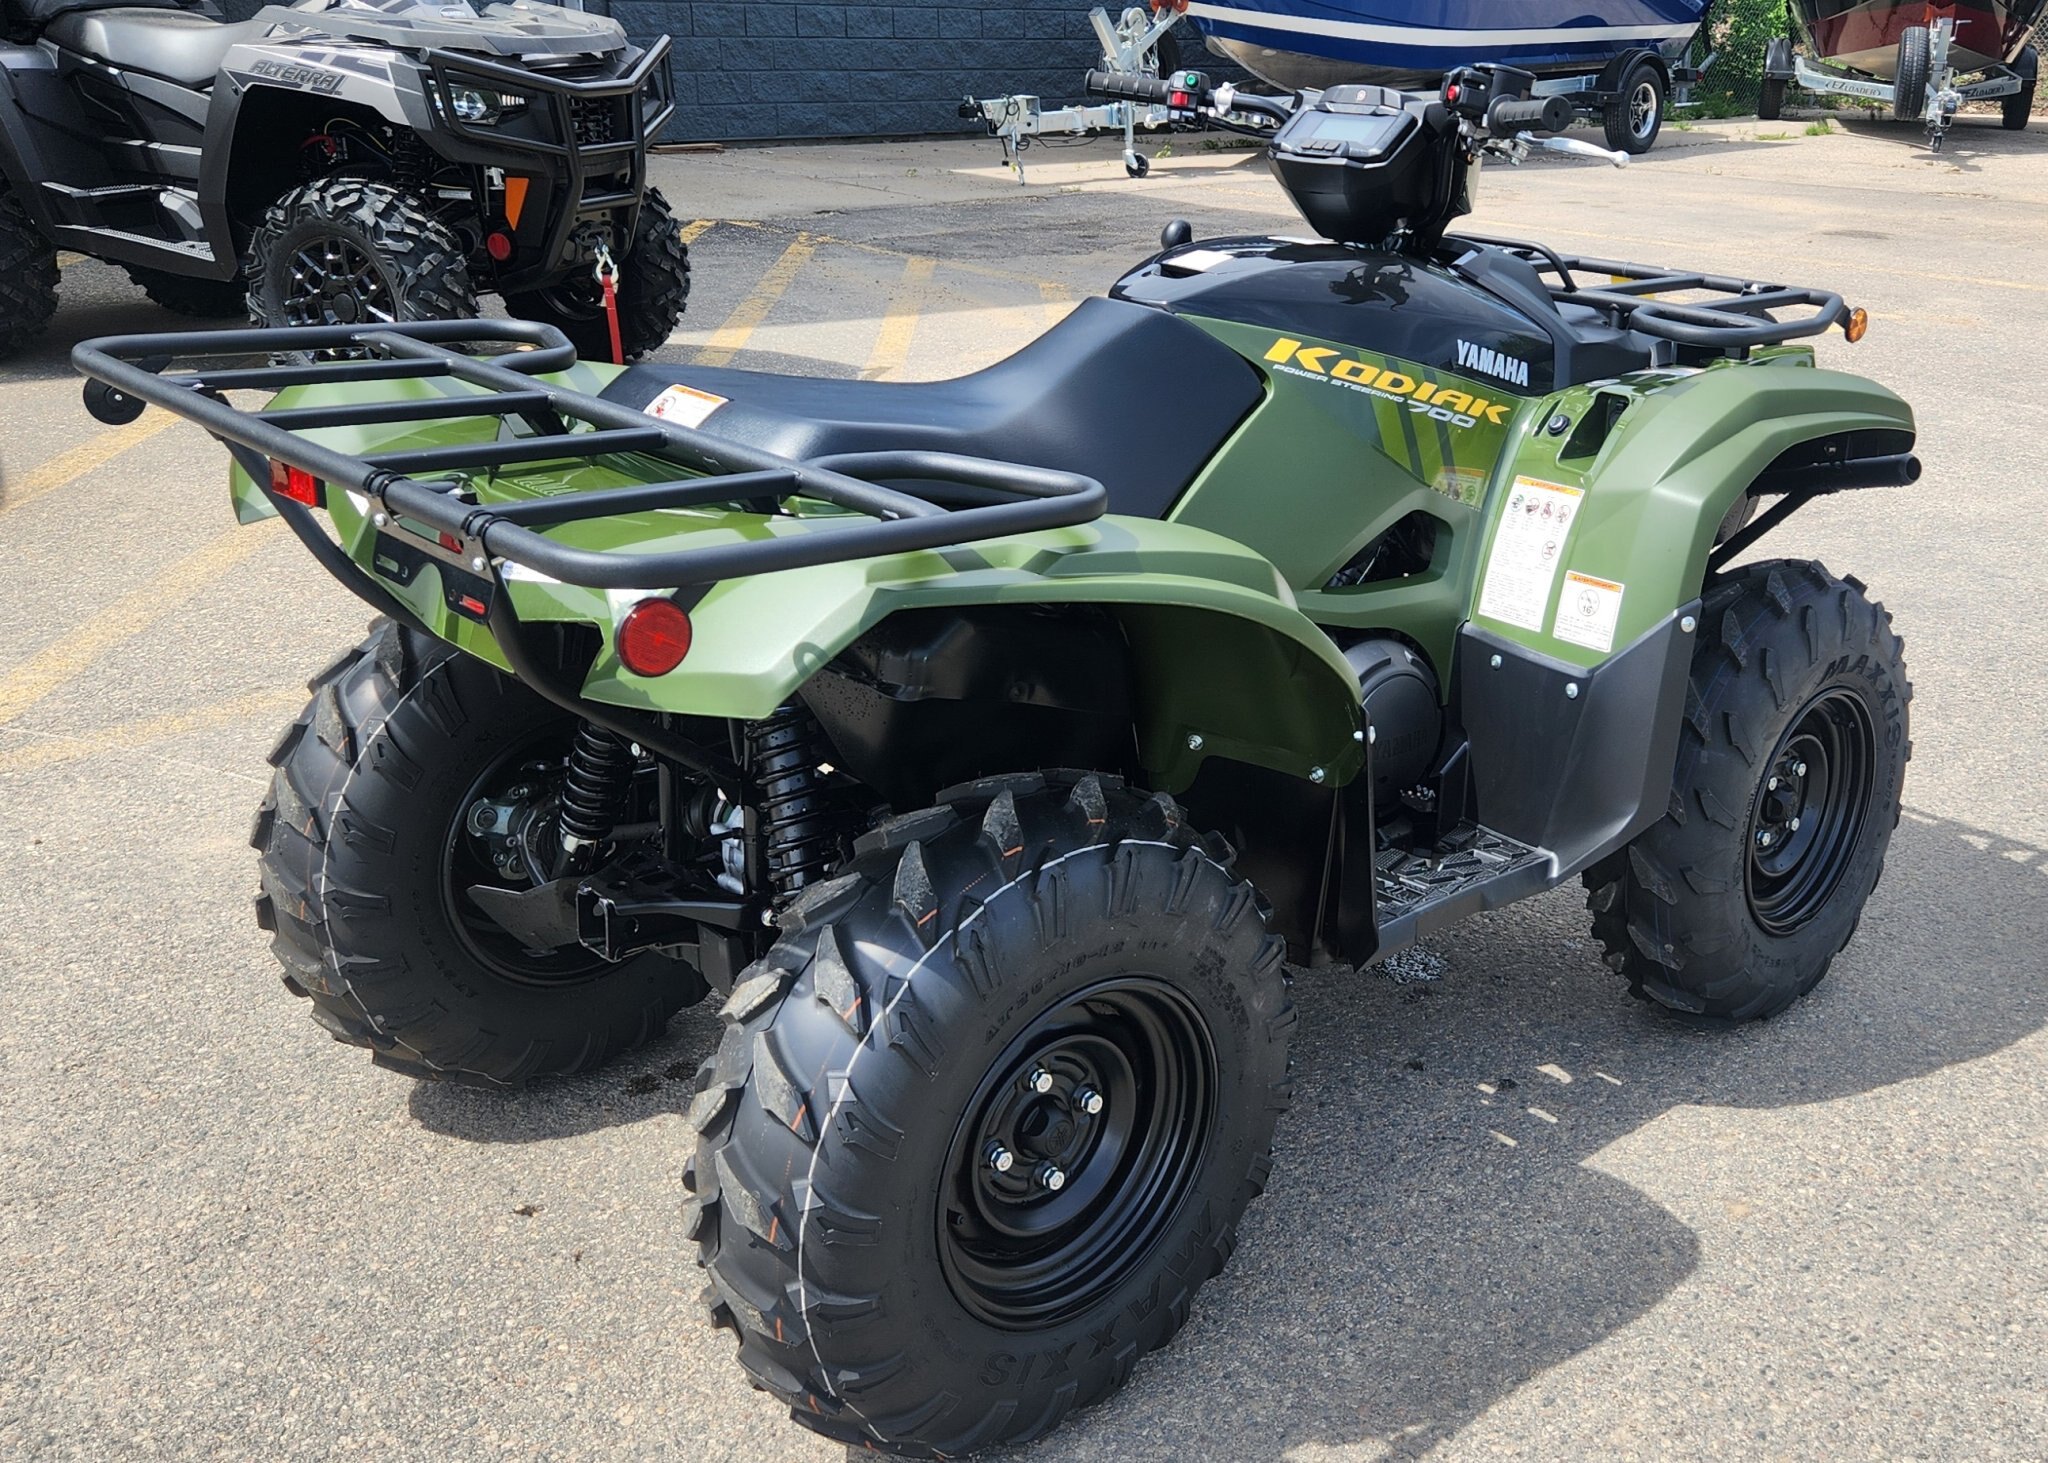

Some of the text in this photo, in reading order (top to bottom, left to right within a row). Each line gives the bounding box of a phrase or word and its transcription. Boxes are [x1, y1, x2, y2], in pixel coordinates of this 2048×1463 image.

[248, 60, 336, 89] ALTERRA
[1263, 337, 1511, 425] KODIAK
[1272, 363, 1477, 429] POWER STEERING 700
[1457, 338, 1529, 387] YAMAHA
[1818, 655, 1901, 748] MAXXIS
[977, 1200, 1213, 1388] MAXXIS
